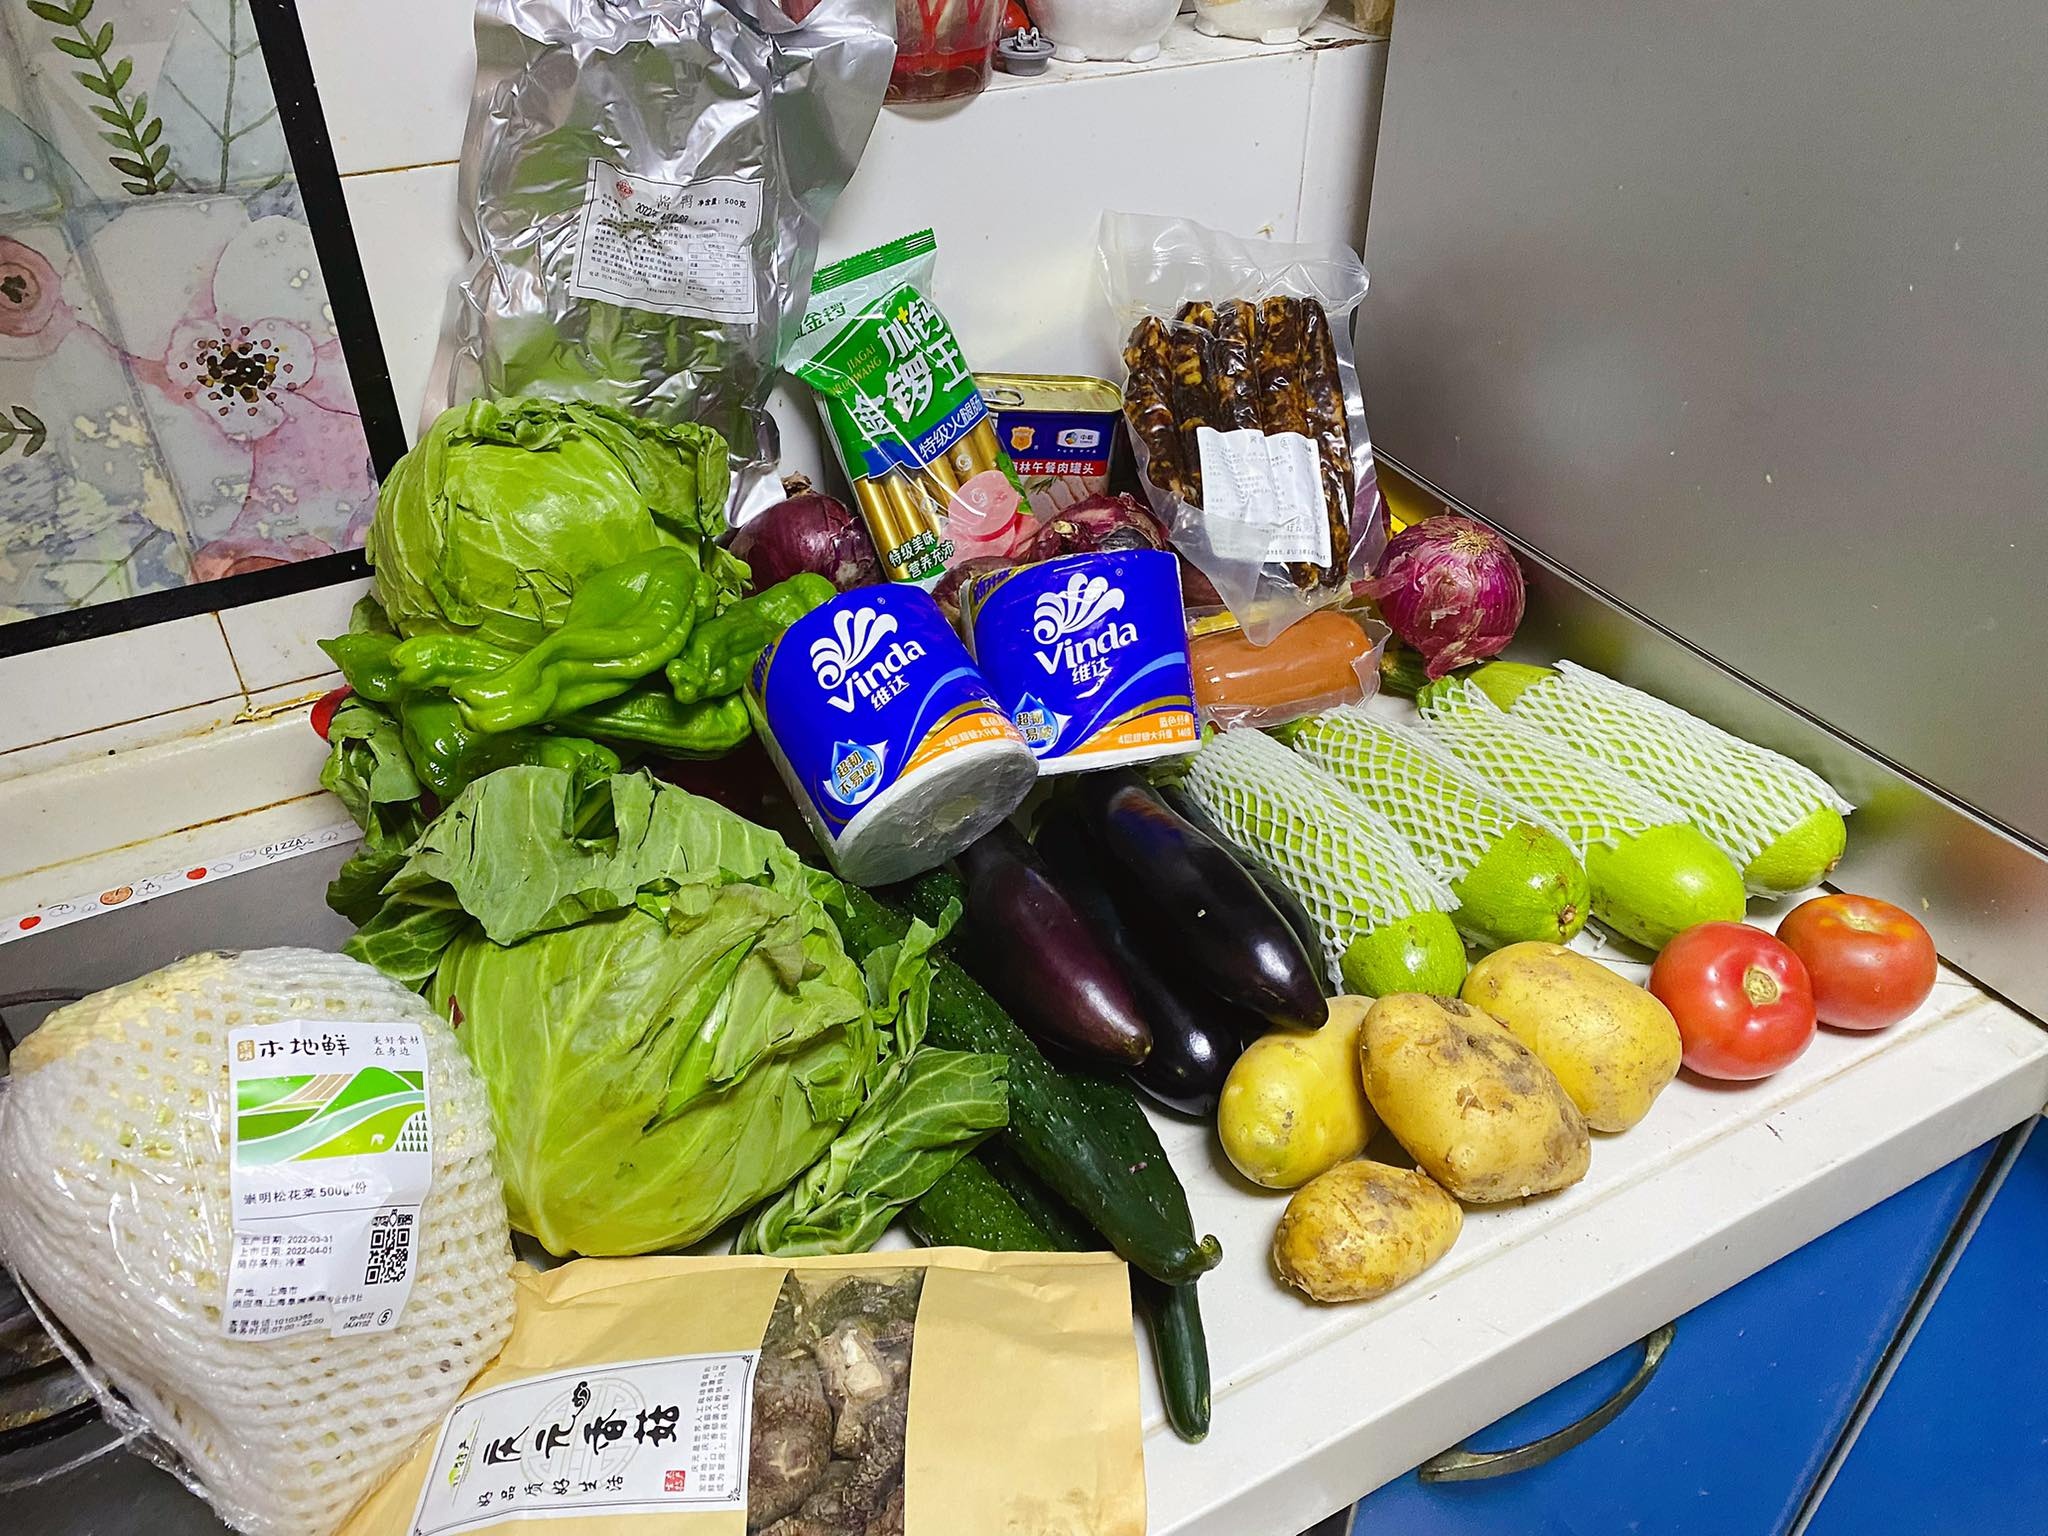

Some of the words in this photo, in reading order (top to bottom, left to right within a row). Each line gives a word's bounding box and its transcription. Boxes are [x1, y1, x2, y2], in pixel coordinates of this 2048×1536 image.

[724, 198, 747, 208] 500克
[919, 393, 984, 461] 特级火腿肠
[889, 530, 936, 567] 特级美味
[908, 541, 955, 579] 营养充沛
[1034, 622, 1138, 676] Vinda
[827, 638, 926, 714] Vinda
[1072, 656, 1110, 688] 维达
[869, 676, 911, 712] 维达
[838, 760, 876, 795] 不易破
[265, 838, 303, 855] PIZZA
[259, 1034, 350, 1059] 本地鲜
[374, 1047, 411, 1057] 在身边
[286, 1246, 333, 1255] 2022-04-01
[287, 1235, 333, 1244] 2022-03-31
[483, 1392, 680, 1466] 庆元香菇
[477, 1475, 624, 1508] 好品质好生活
